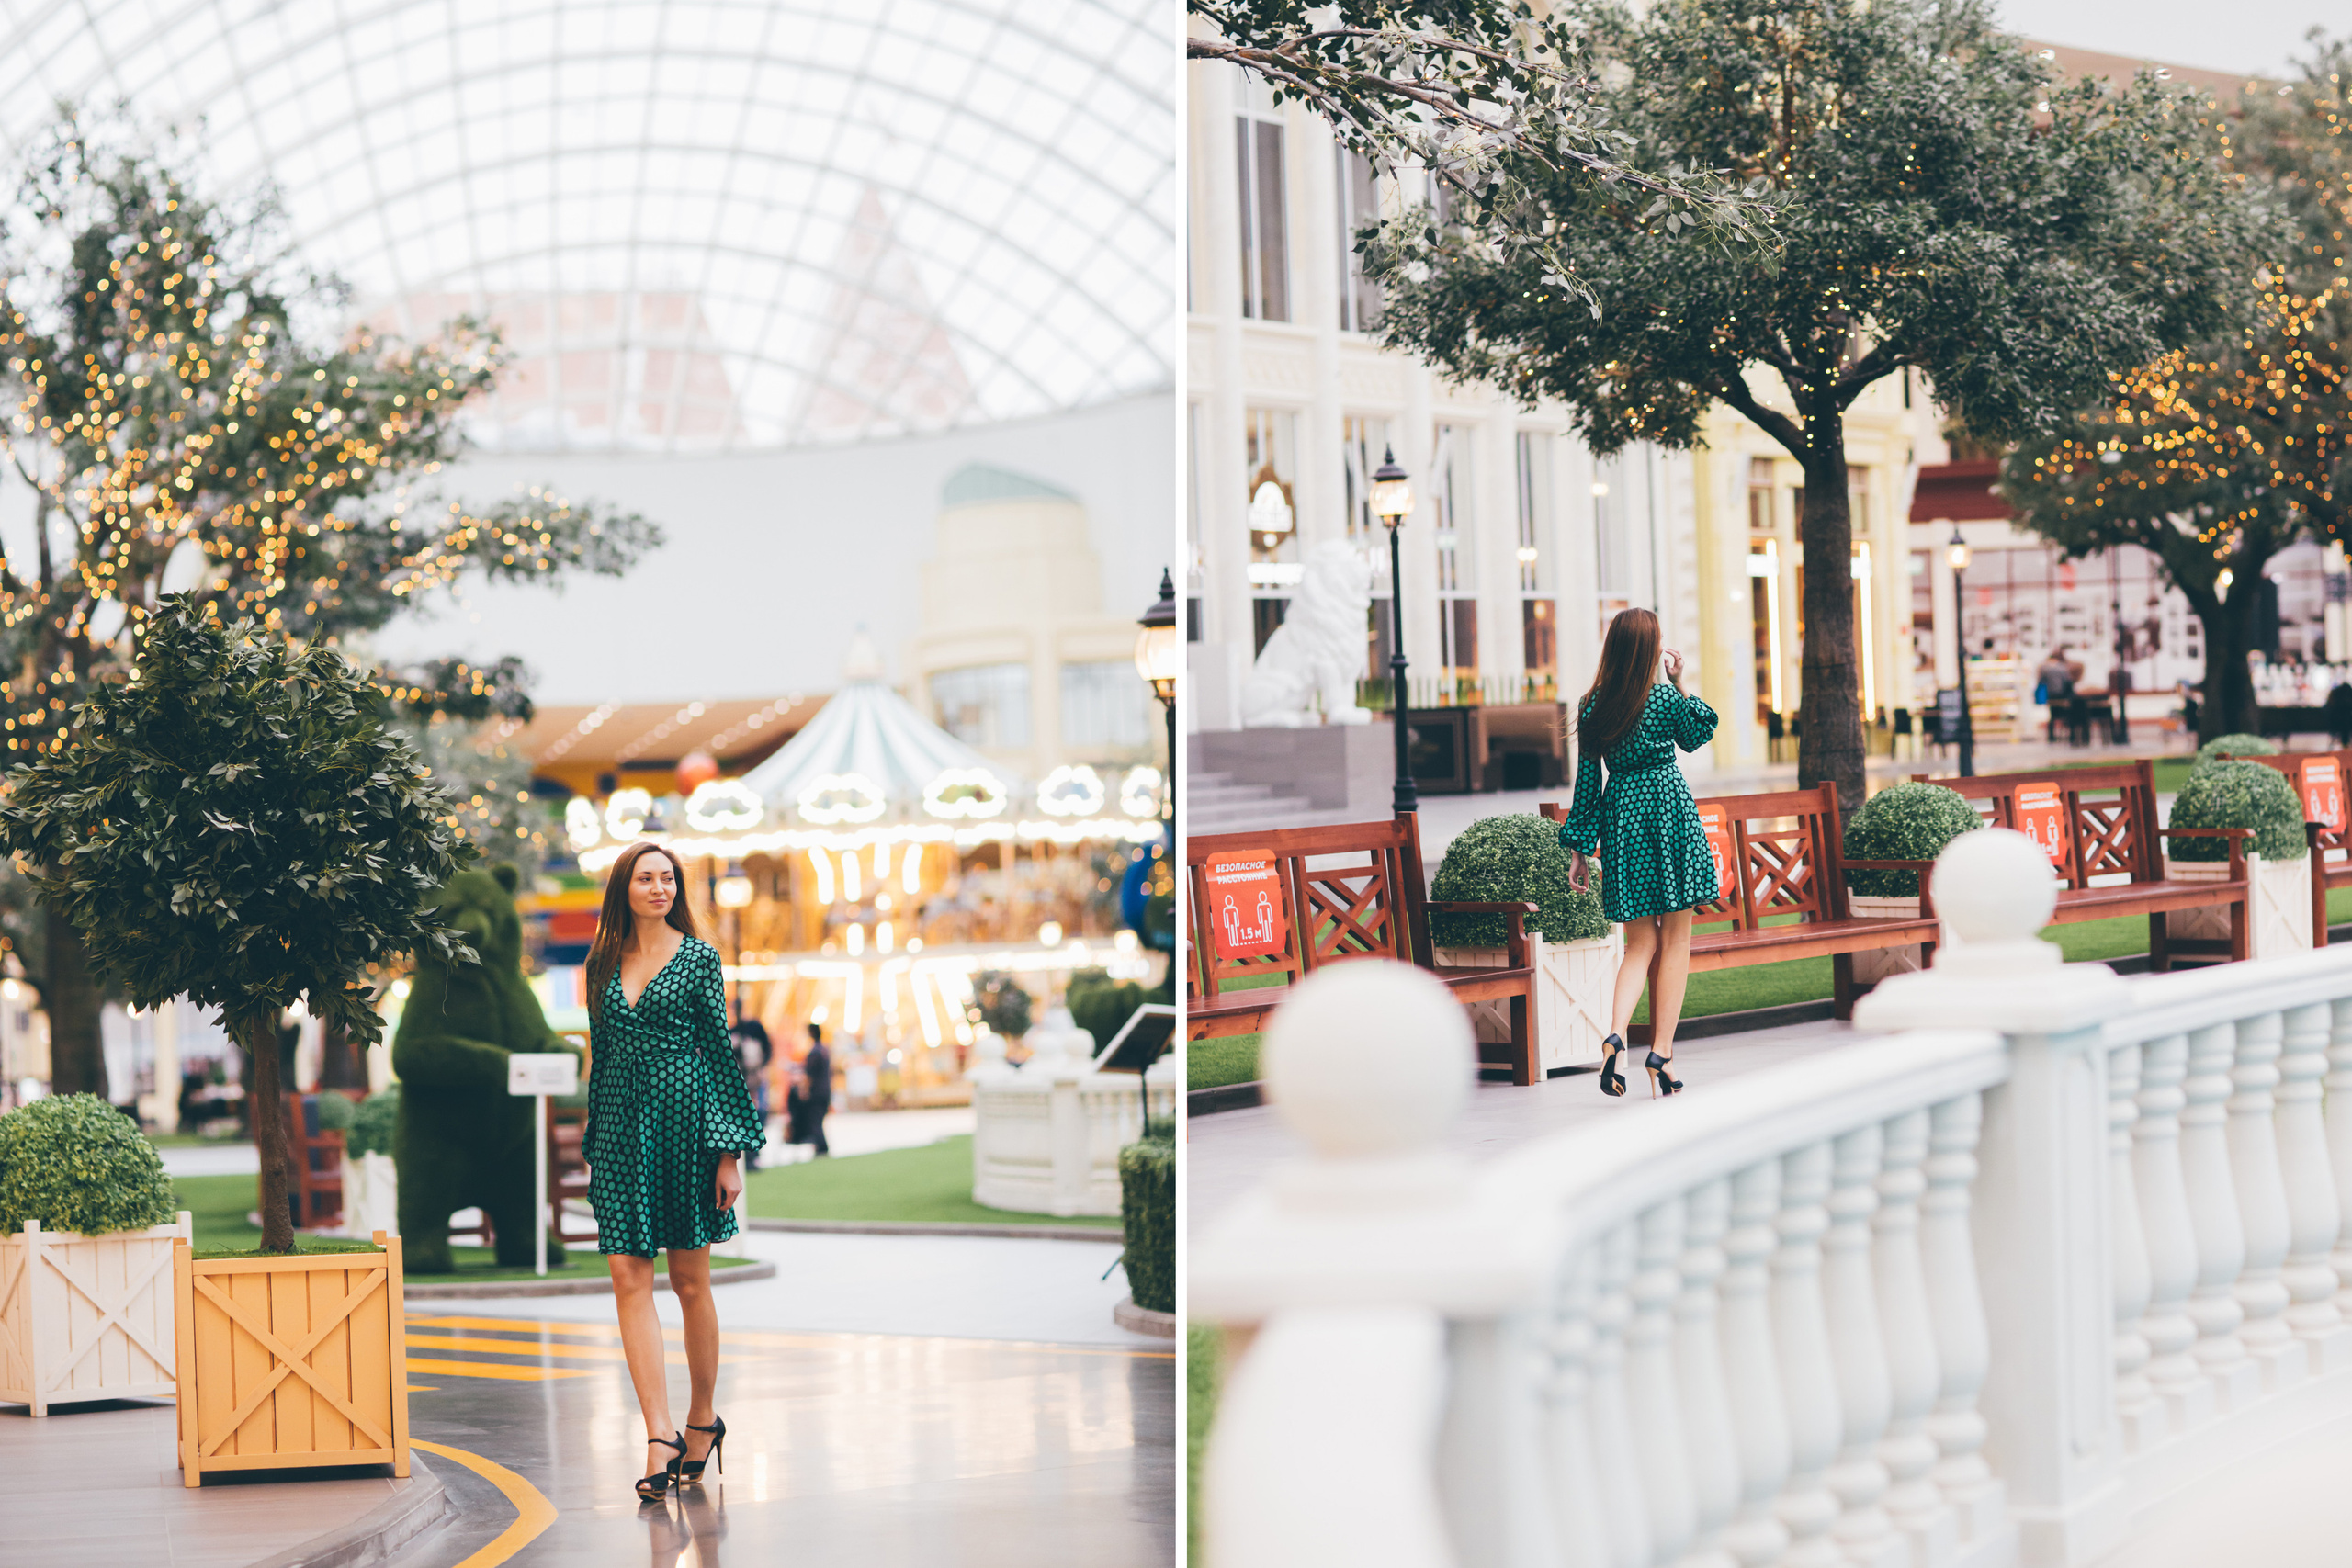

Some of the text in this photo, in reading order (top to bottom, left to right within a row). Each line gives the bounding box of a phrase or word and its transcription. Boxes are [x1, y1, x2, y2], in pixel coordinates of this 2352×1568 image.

[1216, 861, 1266, 873] БЕЗОПАСНОЕ
[1216, 872, 1268, 885] РАССТОЯНИЕ
[1240, 927, 1253, 940] 1.5
